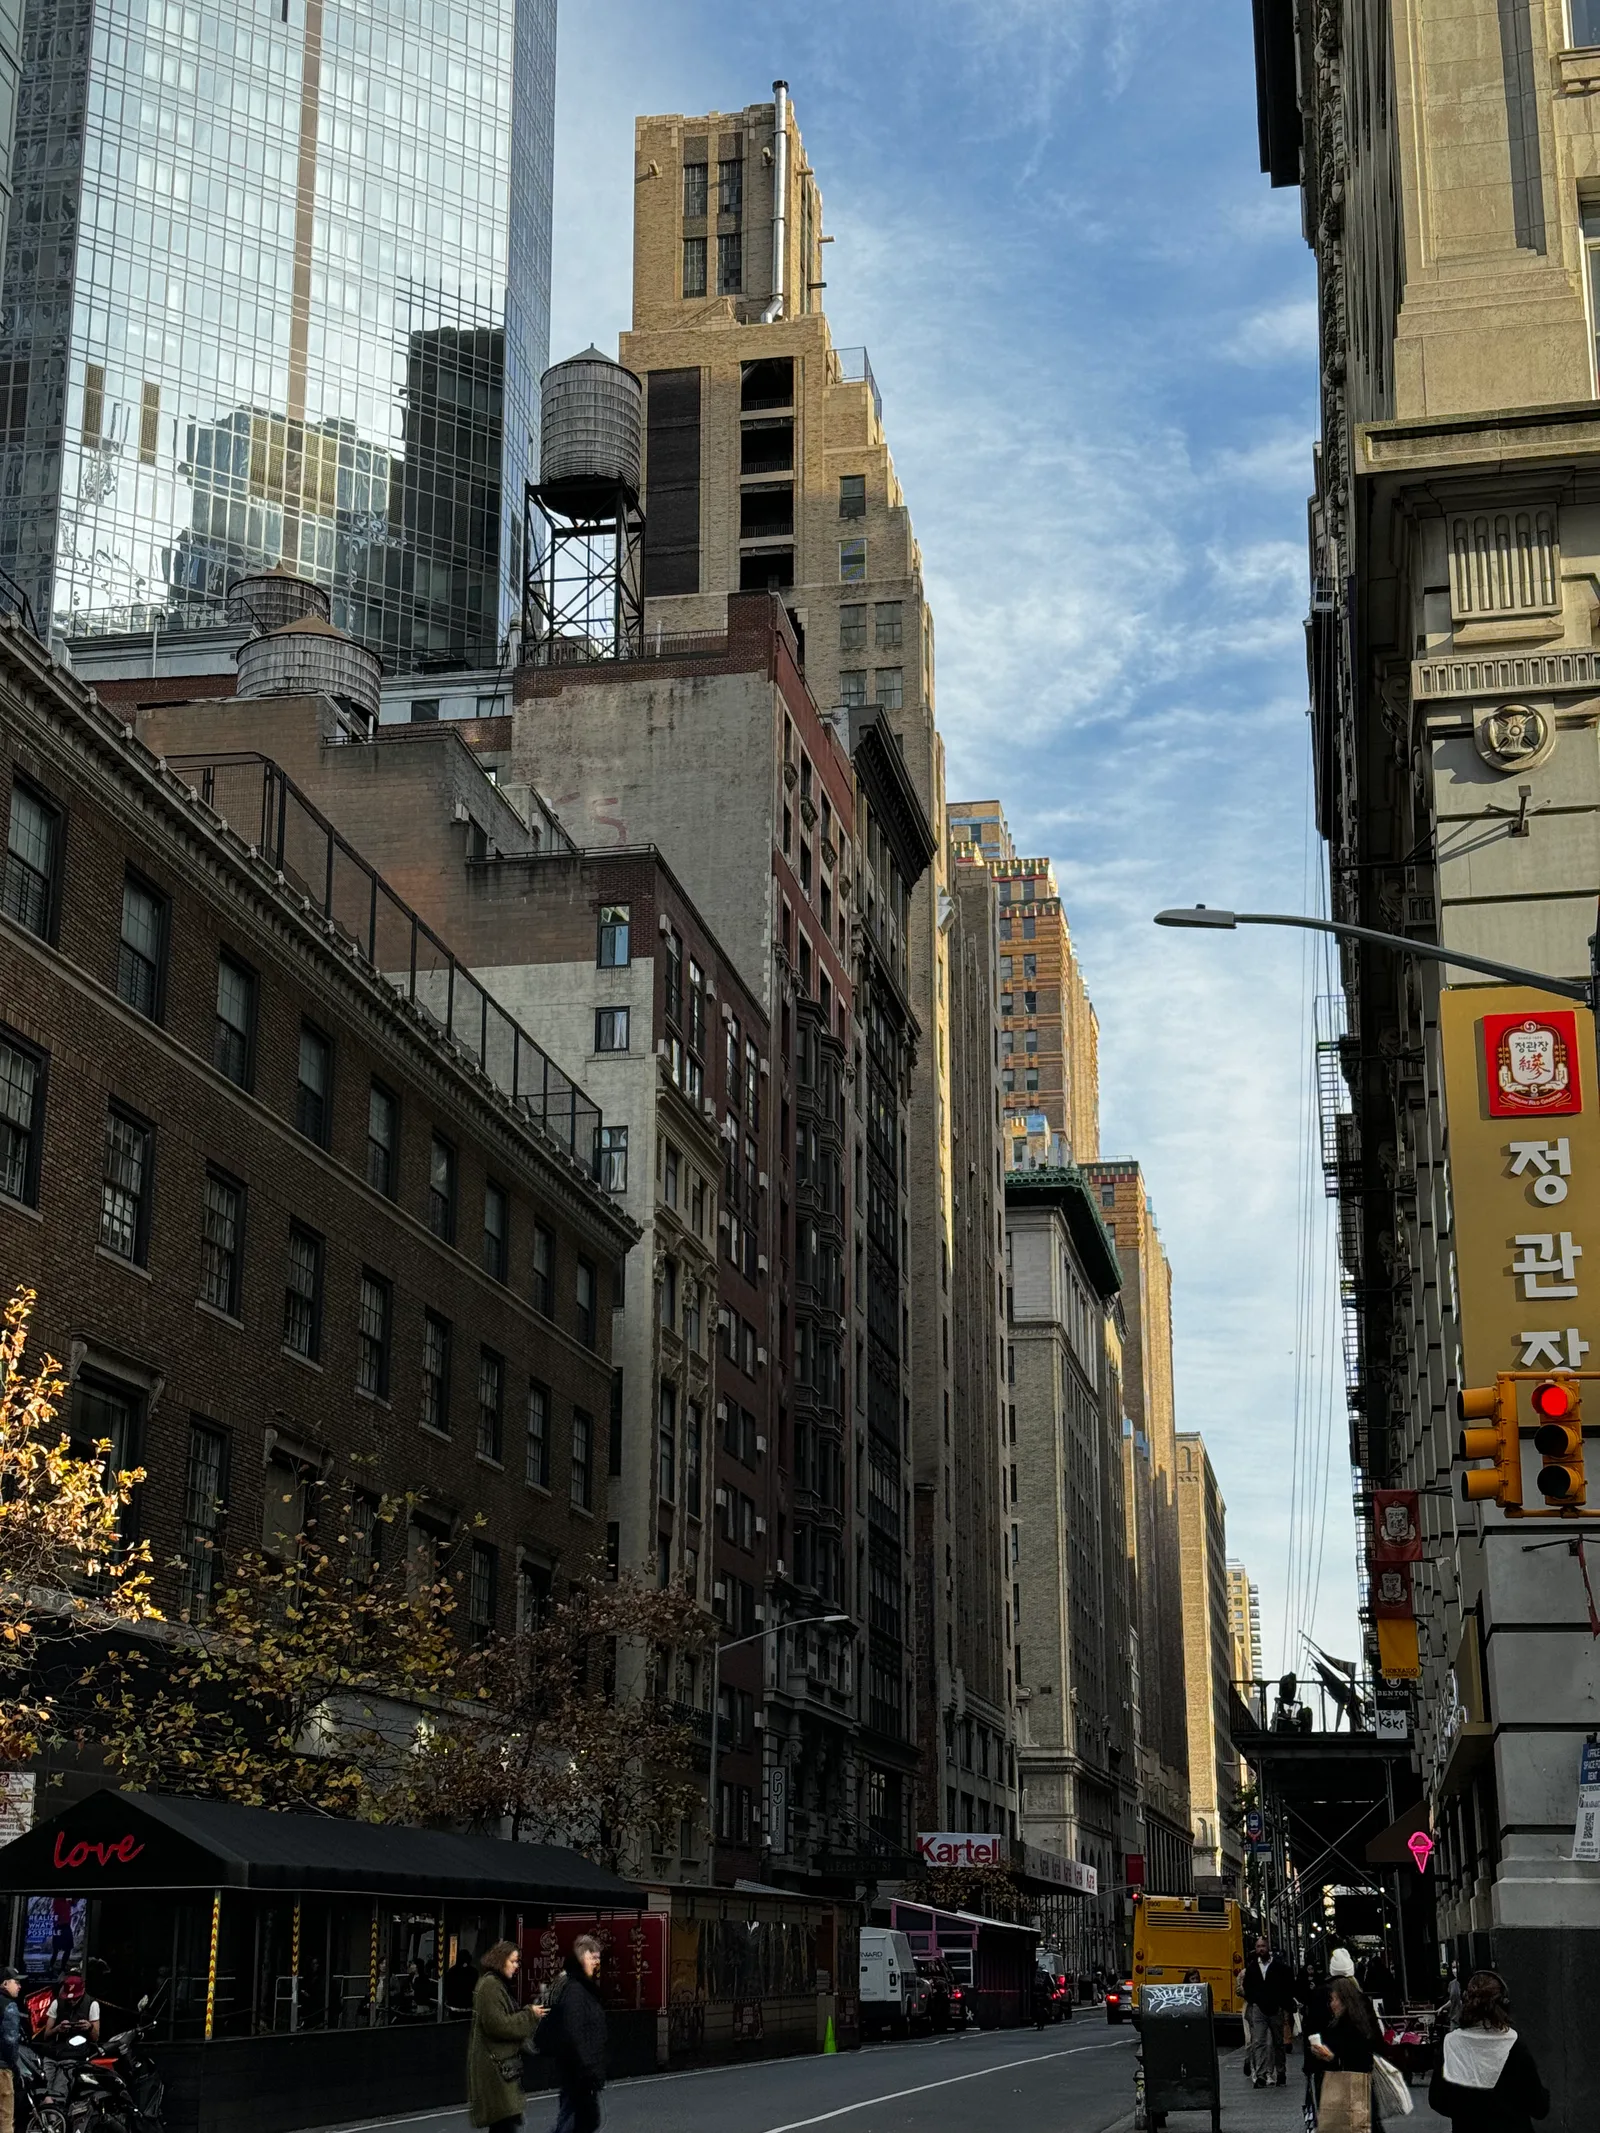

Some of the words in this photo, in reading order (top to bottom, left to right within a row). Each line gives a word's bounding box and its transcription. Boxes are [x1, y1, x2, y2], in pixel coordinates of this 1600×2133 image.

[1515, 1041, 1549, 1053] 정관장
[1530, 1084, 1538, 1093] 6
[533, 1956, 565, 1969] NEW
